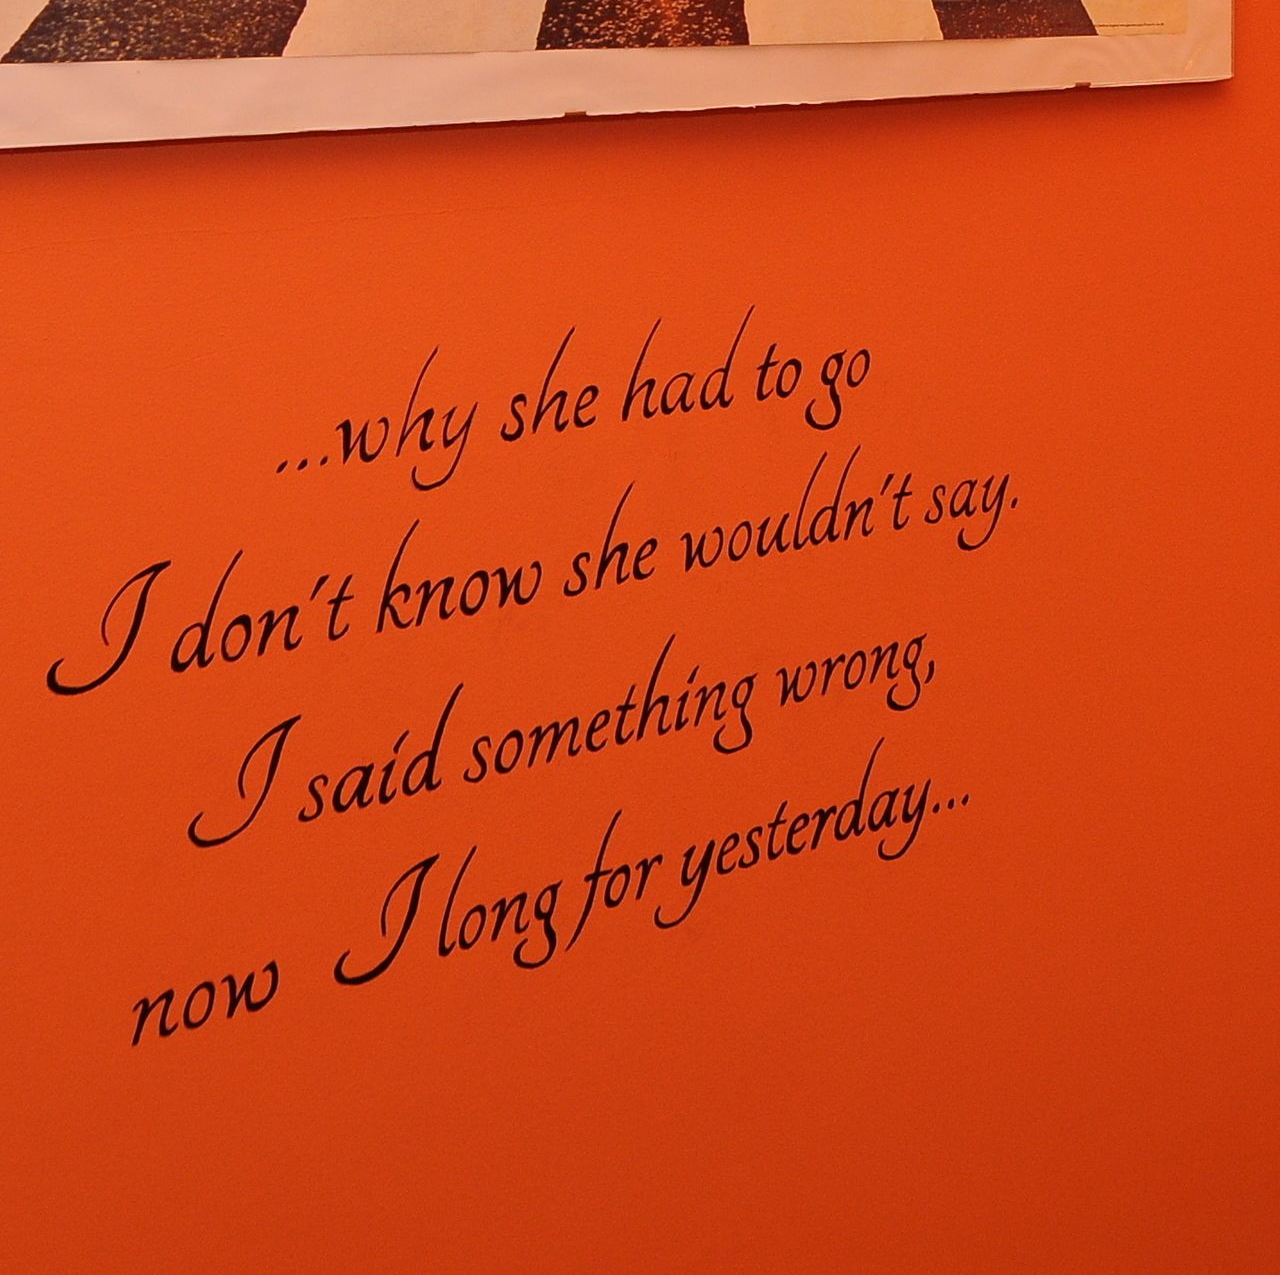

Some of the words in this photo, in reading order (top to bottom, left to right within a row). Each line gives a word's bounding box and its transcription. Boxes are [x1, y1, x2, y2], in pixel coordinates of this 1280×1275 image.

[276, 346, 477, 492] ...why
[500, 327, 599, 442] she
[621, 306, 754, 422] had
[756, 343, 802, 401] to
[804, 348, 871, 431] go
[46, 560, 172, 696] I
[170, 550, 354, 673] don't
[376, 519, 542, 633] know
[563, 483, 658, 597] she
[681, 445, 913, 572] wouldn't
[924, 474, 1018, 551] say.
[187, 714, 302, 848] I
[298, 683, 464, 823] said
[463, 633, 757, 784] something
[776, 633, 935, 712] wrong,
[131, 960, 279, 1046] now
[333, 853, 440, 986] I
[438, 845, 562, 970] long
[566, 809, 664, 950] for
[653, 737, 969, 930] yesterday...
